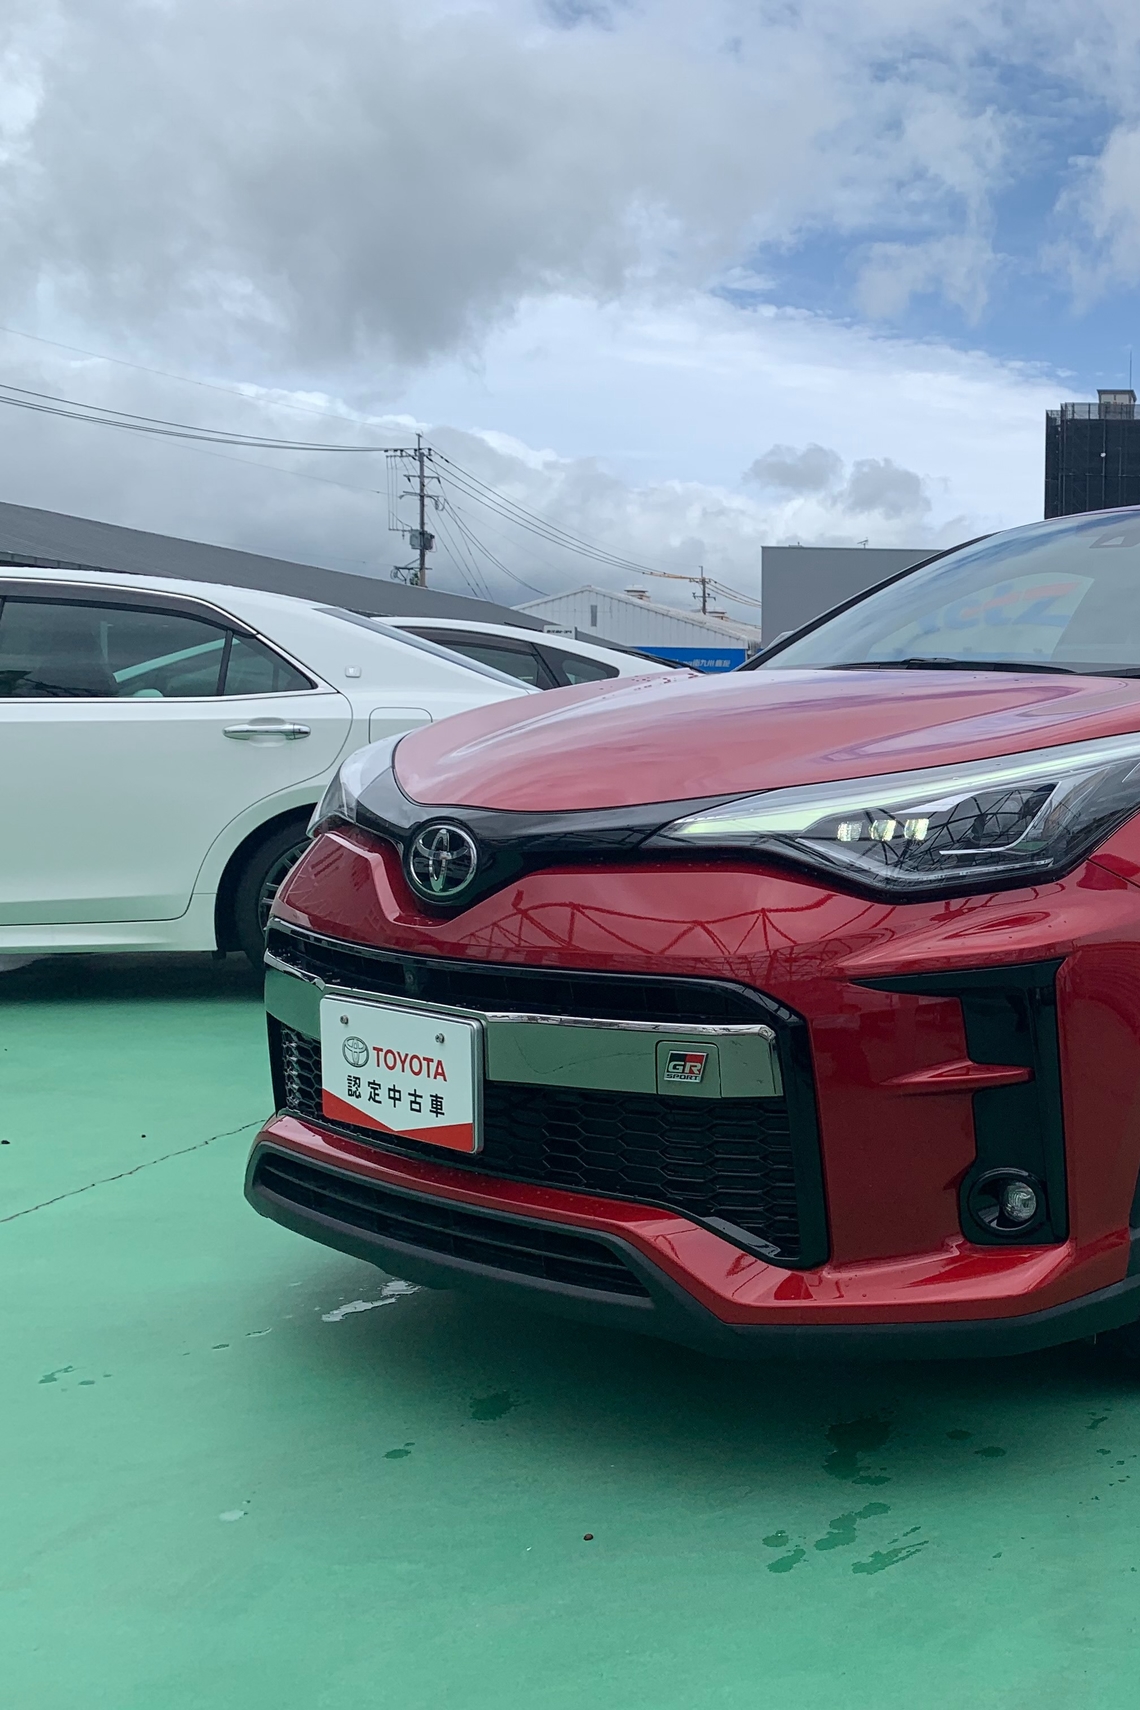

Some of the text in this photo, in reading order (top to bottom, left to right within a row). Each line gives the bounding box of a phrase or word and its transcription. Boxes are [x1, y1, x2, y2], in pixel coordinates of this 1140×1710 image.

[372, 1046, 448, 1082] TOYOTA
[667, 1061, 702, 1075] GR
[666, 1073, 700, 1081] SPORT
[346, 1074, 446, 1118] 認定中古車
